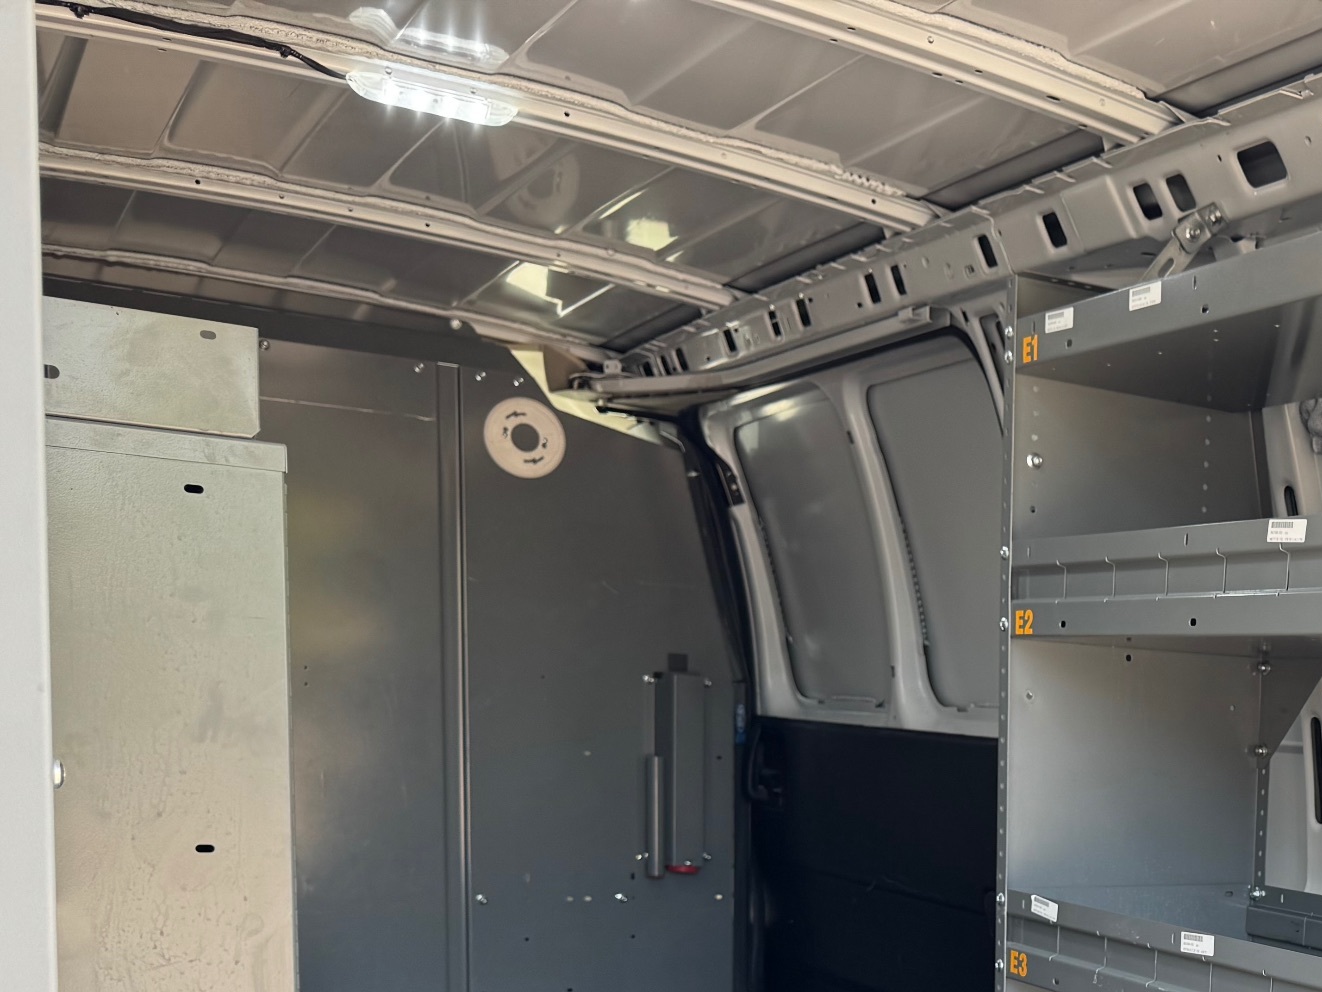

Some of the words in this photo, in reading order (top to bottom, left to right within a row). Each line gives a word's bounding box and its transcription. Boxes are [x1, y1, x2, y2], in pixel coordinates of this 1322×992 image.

[1022, 335, 1039, 364] E1
[1015, 610, 1034, 635] E2
[1010, 950, 1028, 977] E3
